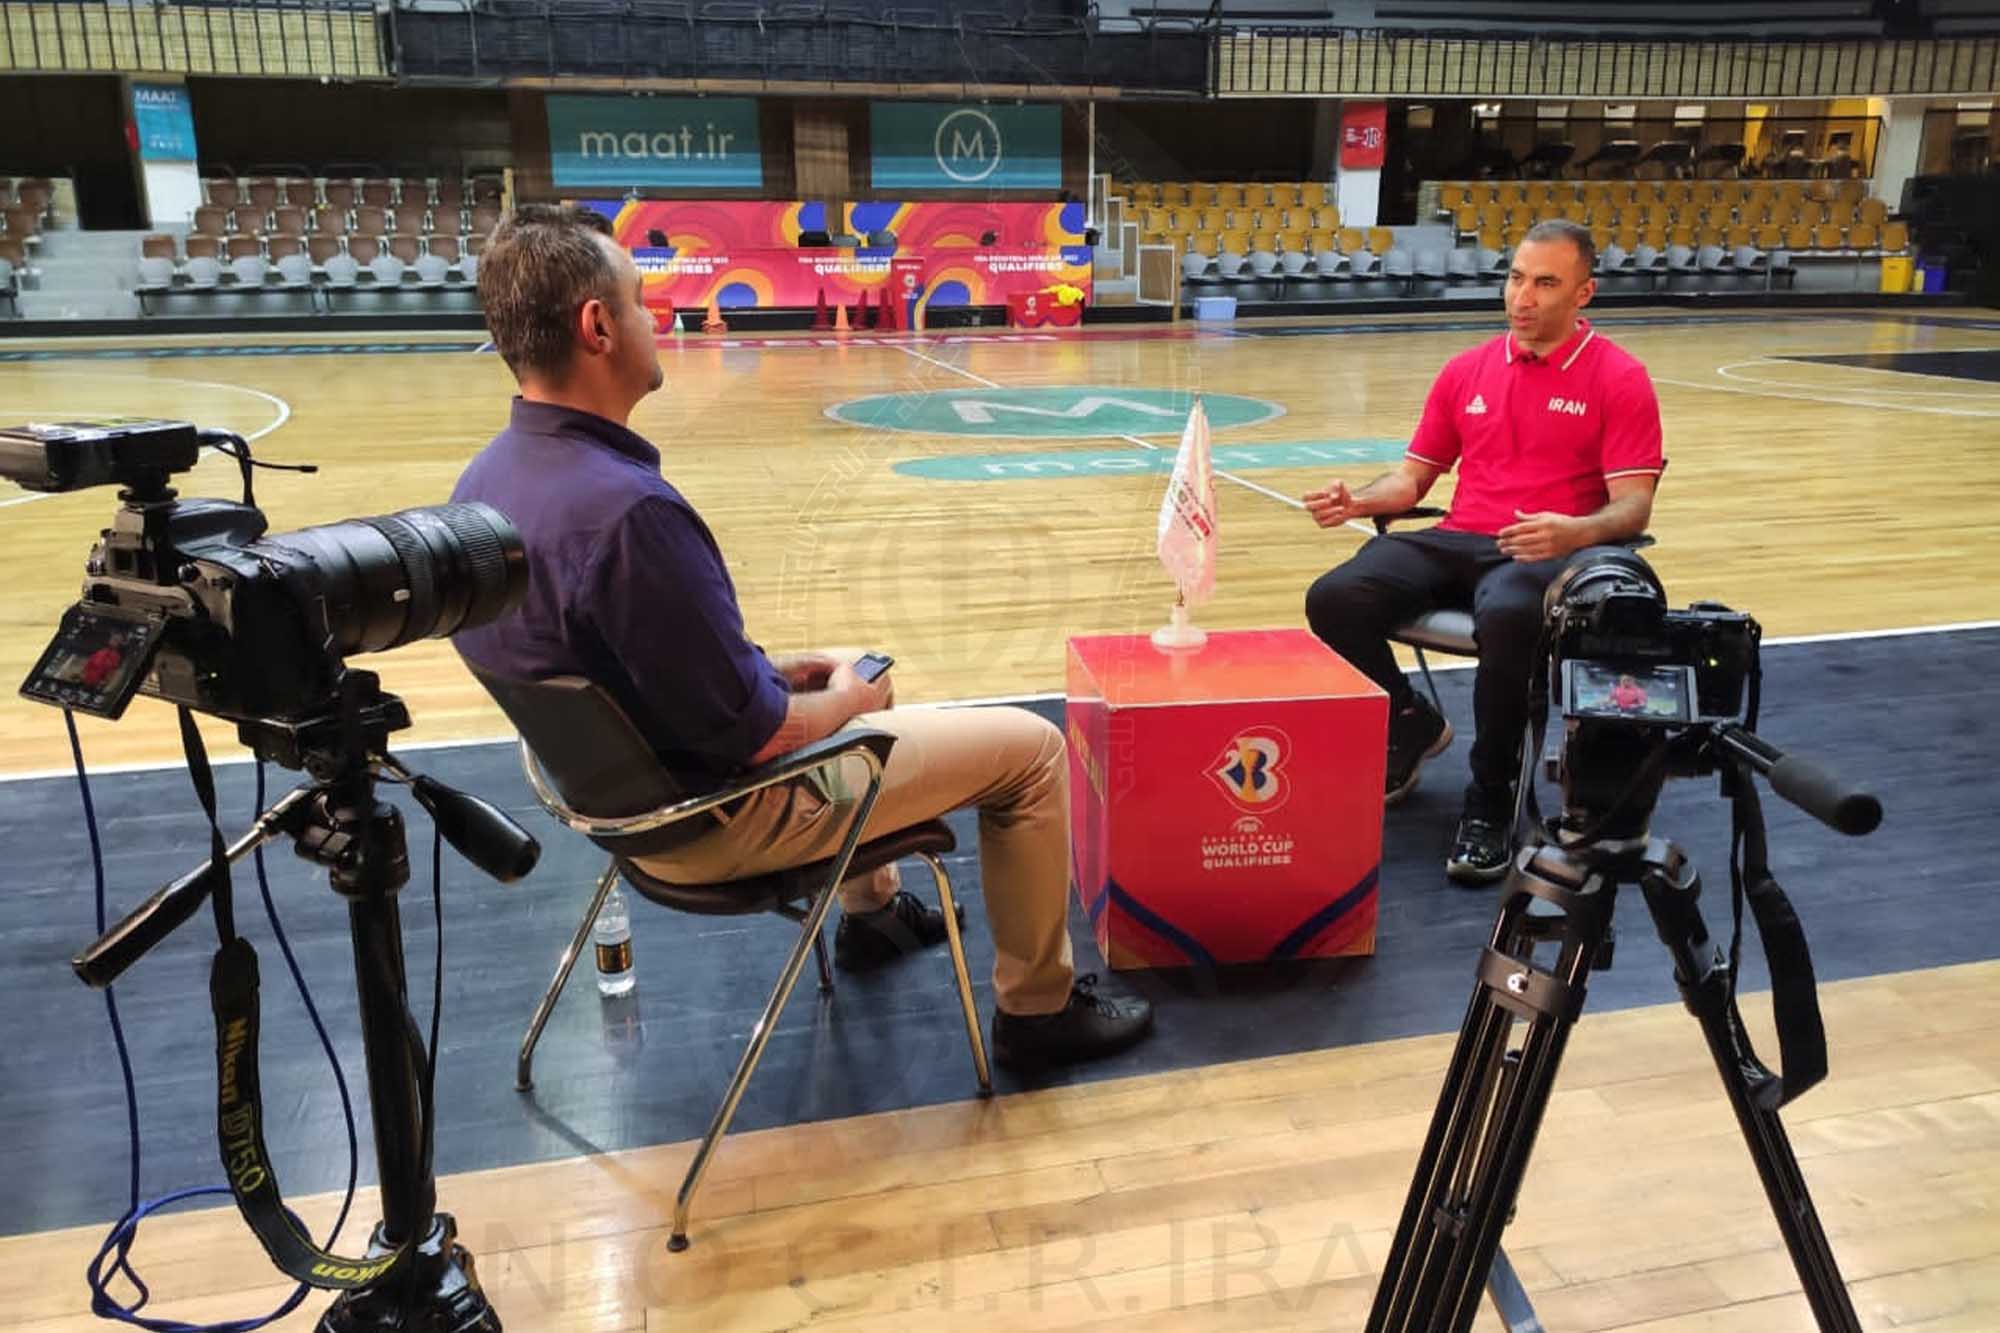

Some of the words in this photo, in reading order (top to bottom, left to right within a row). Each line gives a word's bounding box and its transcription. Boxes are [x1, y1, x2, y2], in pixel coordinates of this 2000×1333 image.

[579, 123, 734, 160] maat.ir
[951, 129, 986, 162] M
[988, 262, 1064, 274] QUALIFIERS
[1547, 397, 1586, 416] IRAN
[1201, 842, 1259, 856] WORLD
[1262, 840, 1294, 854] CUP
[1202, 855, 1293, 870] QUALIFIERS
[221, 1016, 249, 1104] Nikon
